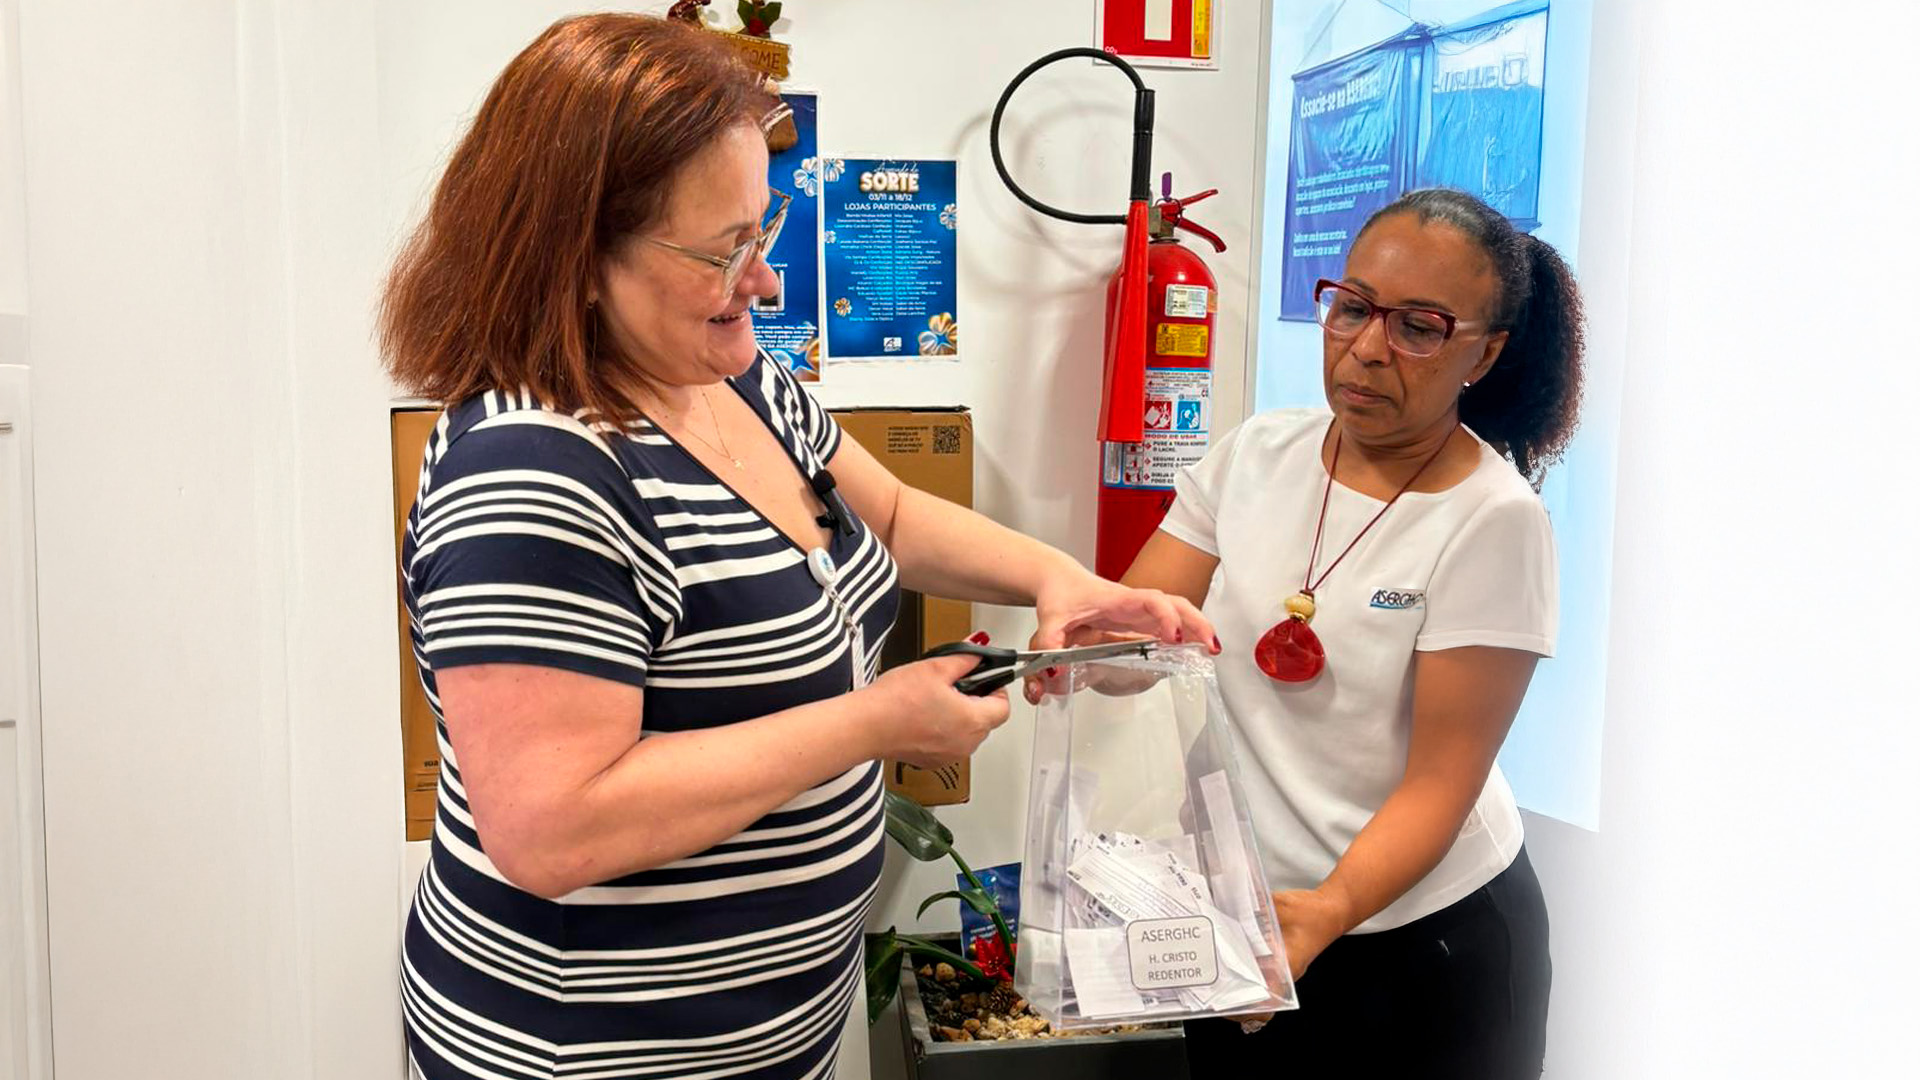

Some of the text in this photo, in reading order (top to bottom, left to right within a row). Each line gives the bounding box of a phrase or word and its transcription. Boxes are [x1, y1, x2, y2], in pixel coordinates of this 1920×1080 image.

[1301, 90, 1336, 118] Associe-se
[1337, 88, 1346, 110] na
[860, 171, 919, 192] SORTE
[868, 193, 887, 201] 03/11
[844, 203, 937, 211] LOJAS PARTICIPANTES
[1141, 926, 1201, 942] ASERGHC
[1149, 951, 1197, 963] H. CRISTO
[1148, 967, 1202, 981] REDENTOR
